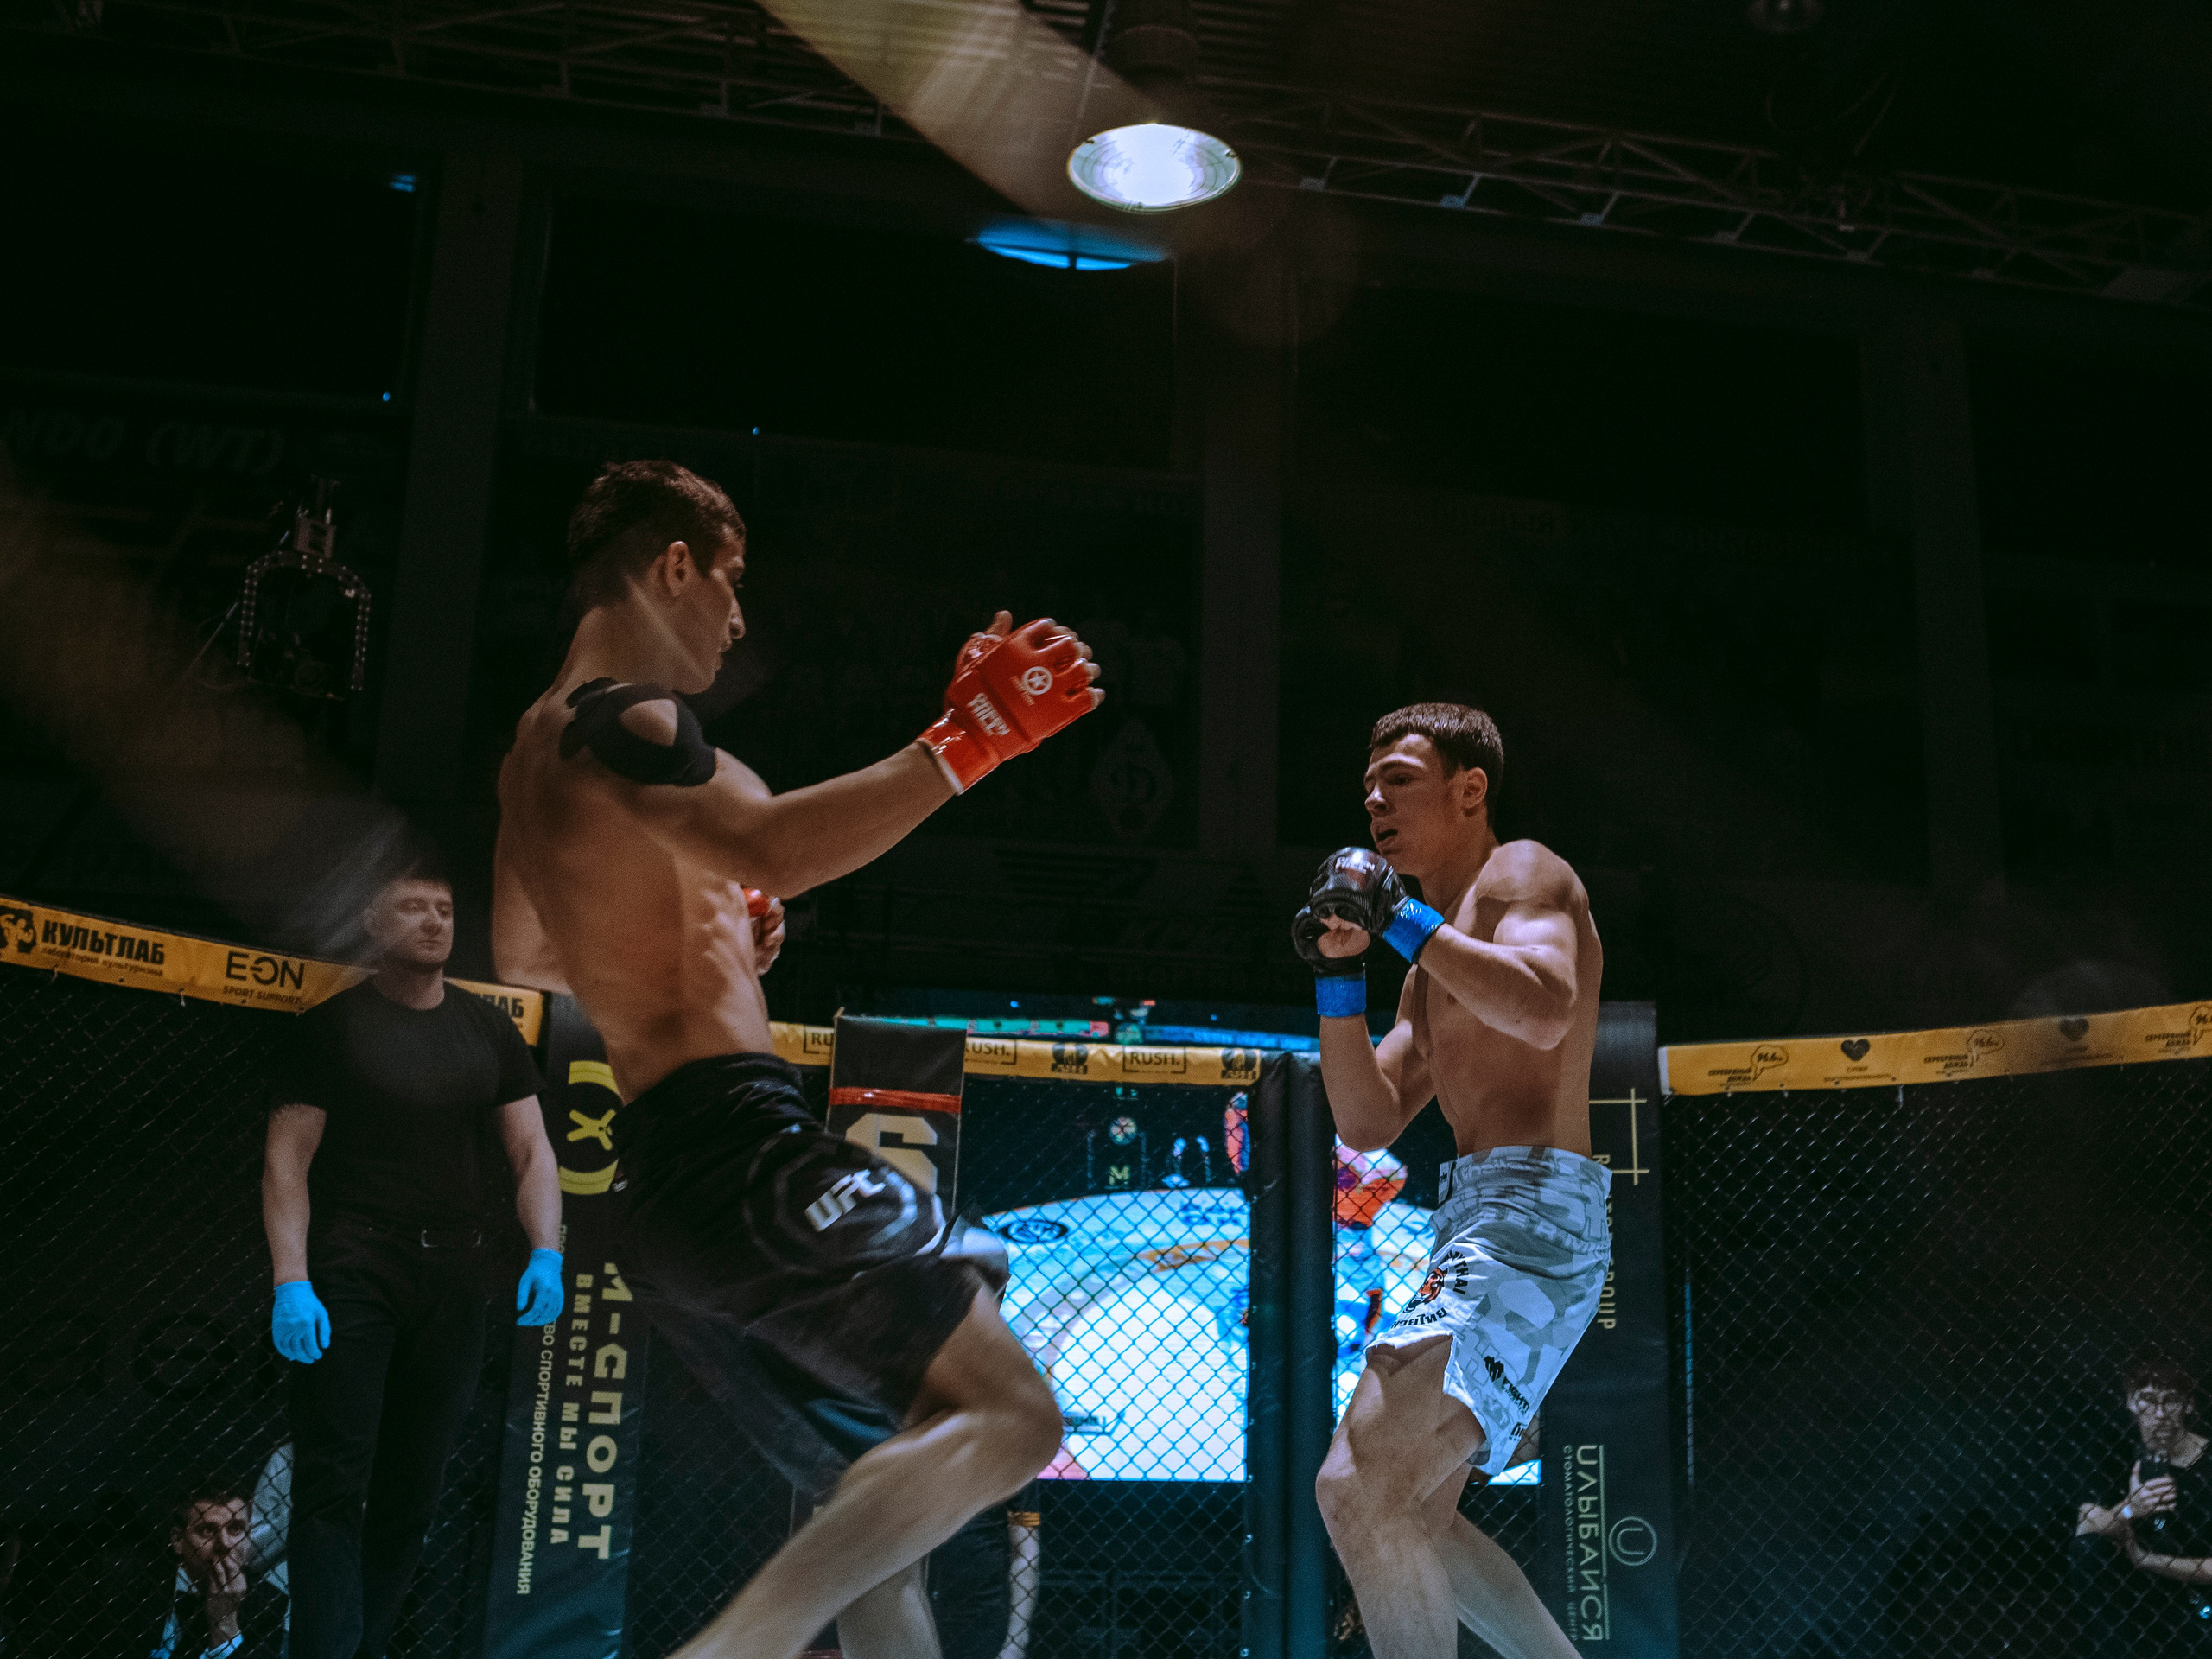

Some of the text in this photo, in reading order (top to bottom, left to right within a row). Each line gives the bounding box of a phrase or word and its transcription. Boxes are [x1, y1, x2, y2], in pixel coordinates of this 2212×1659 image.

[42, 920, 164, 964] КУЛЬТЛАБ
[223, 985, 302, 1005] SPORT SUPPORT
[1129, 1052, 1180, 1065] RUSH.
[804, 1169, 887, 1232] UFC
[1453, 1260, 1470, 1295] THAI
[550, 1273, 594, 1545] ВМЕСТЕ МЫ СИЛА
[516, 1349, 554, 1595] СПОРТИВНОГО ОБОРУДОВАНИЯ
[1562, 1444, 1576, 1593] СТОМАТОЛОГИЧЕСКИЙ
